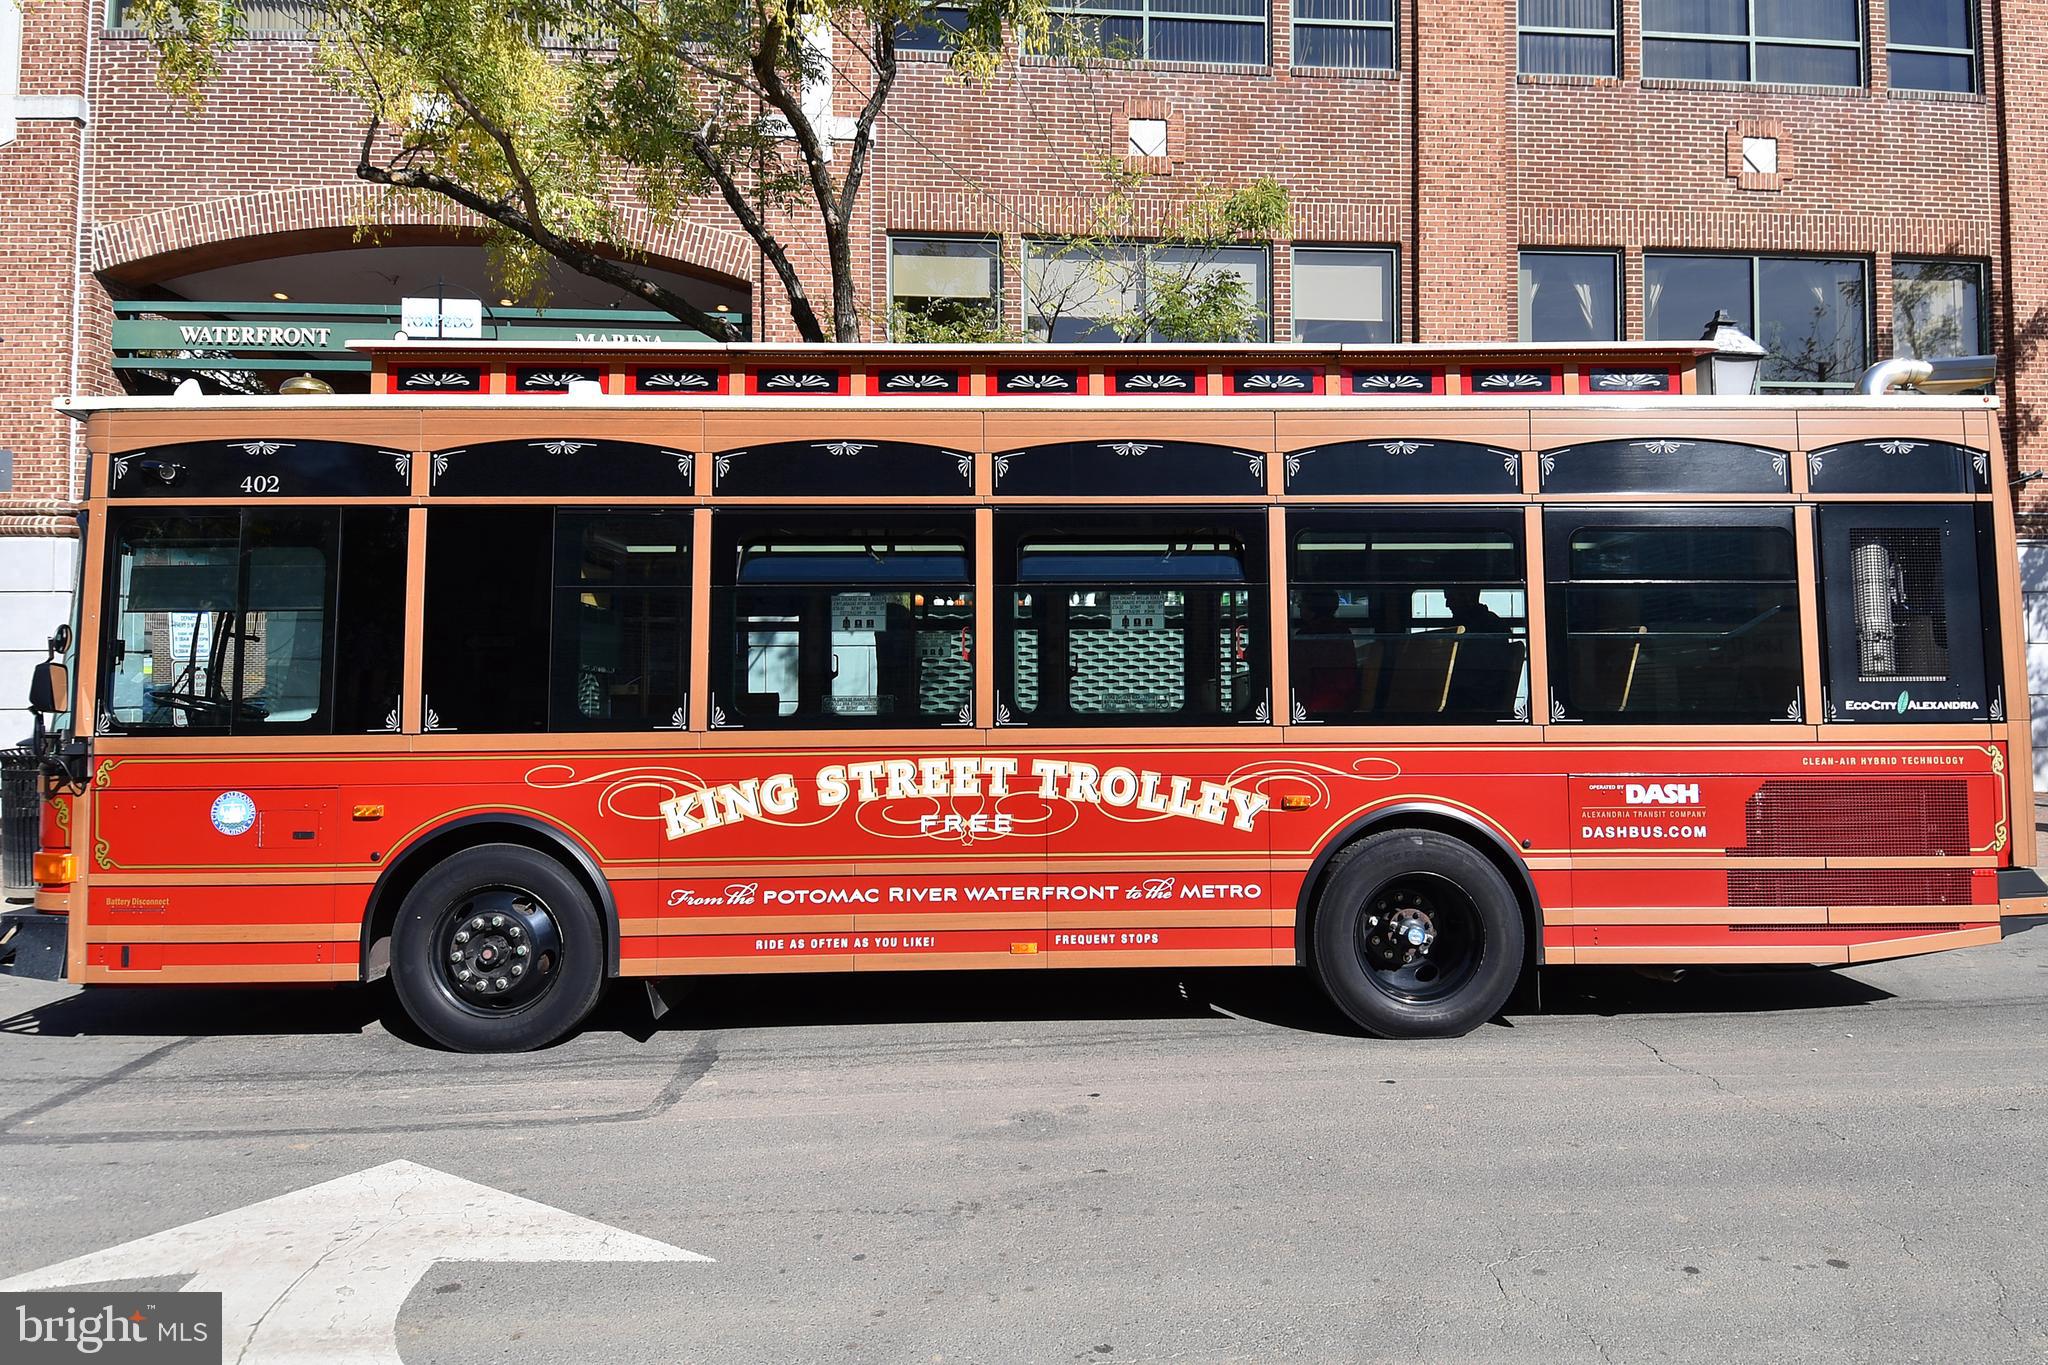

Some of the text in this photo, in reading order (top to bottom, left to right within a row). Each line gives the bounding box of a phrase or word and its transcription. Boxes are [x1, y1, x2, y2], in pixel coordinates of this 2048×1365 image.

[404, 314, 474, 329] TORPEDO
[179, 326, 331, 347] WATERFRONT
[240, 475, 280, 493] 402
[1907, 700, 1979, 711] ALEXANDRIA
[1802, 756, 1965, 766] CLEAN-AIR HYBRID TECHNOLOGY
[659, 757, 1270, 841] KING STREET TROLLEY
[1626, 784, 1700, 804] DASH
[1669, 810, 1706, 818] COMPANY
[920, 814, 1014, 833] FREE
[1582, 825, 1707, 839] DASHBUS.COM
[667, 877, 1262, 906] From the POTOMAC RIVER WATERFRONT to the METRO
[105, 898, 170, 907] Battery Disconnect
[755, 937, 935, 950] RIDE AS OFTEN AS YOU LIKE!
[1055, 933, 1159, 945] FREQUENT STOPS
